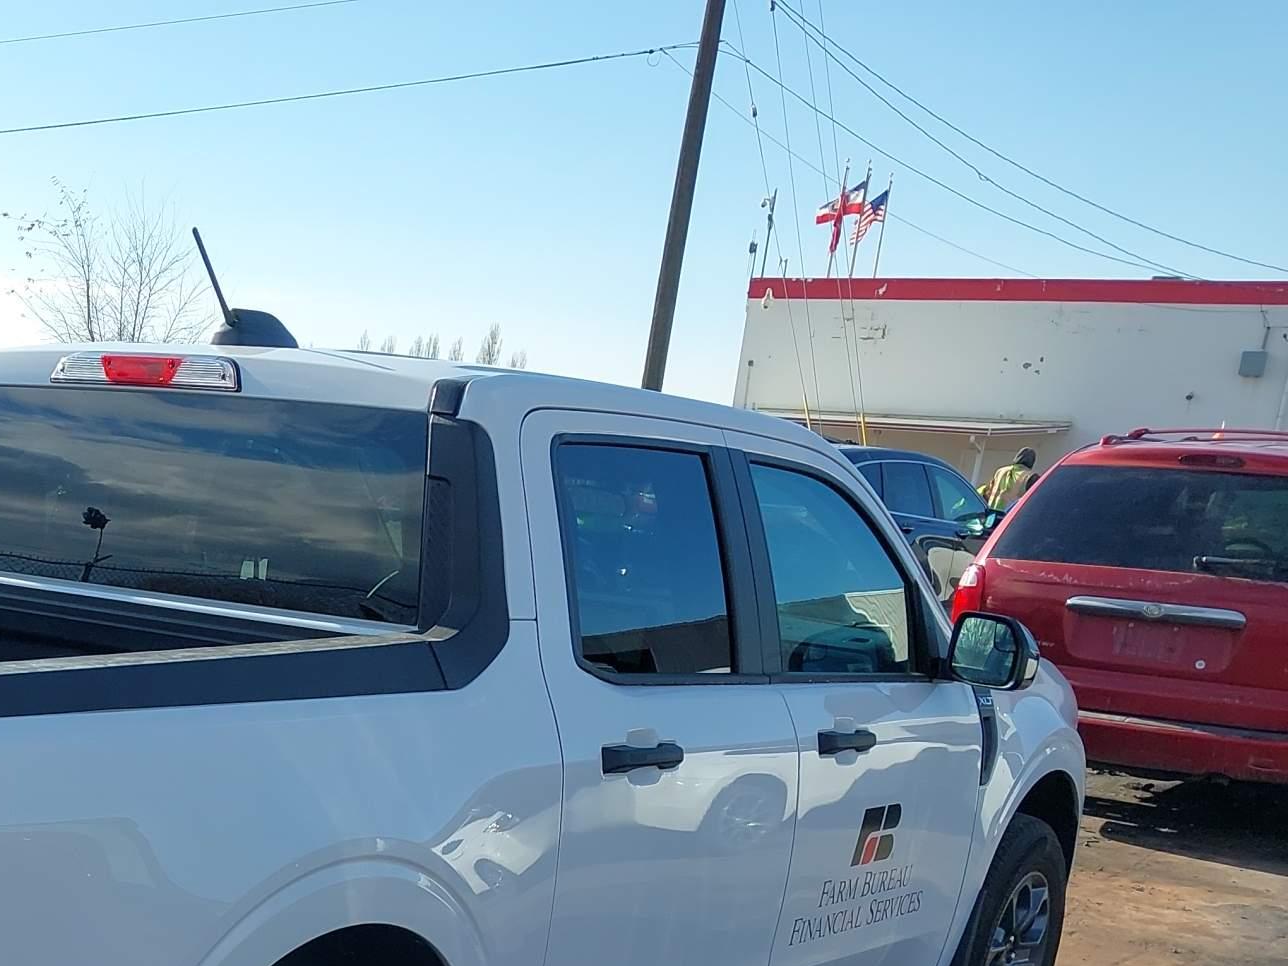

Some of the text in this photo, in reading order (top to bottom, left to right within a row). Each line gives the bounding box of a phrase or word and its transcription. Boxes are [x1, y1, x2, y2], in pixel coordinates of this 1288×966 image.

[818, 864, 914, 907] FARM BUREAU
[789, 890, 923, 945] FINANCIAL SERVICES
